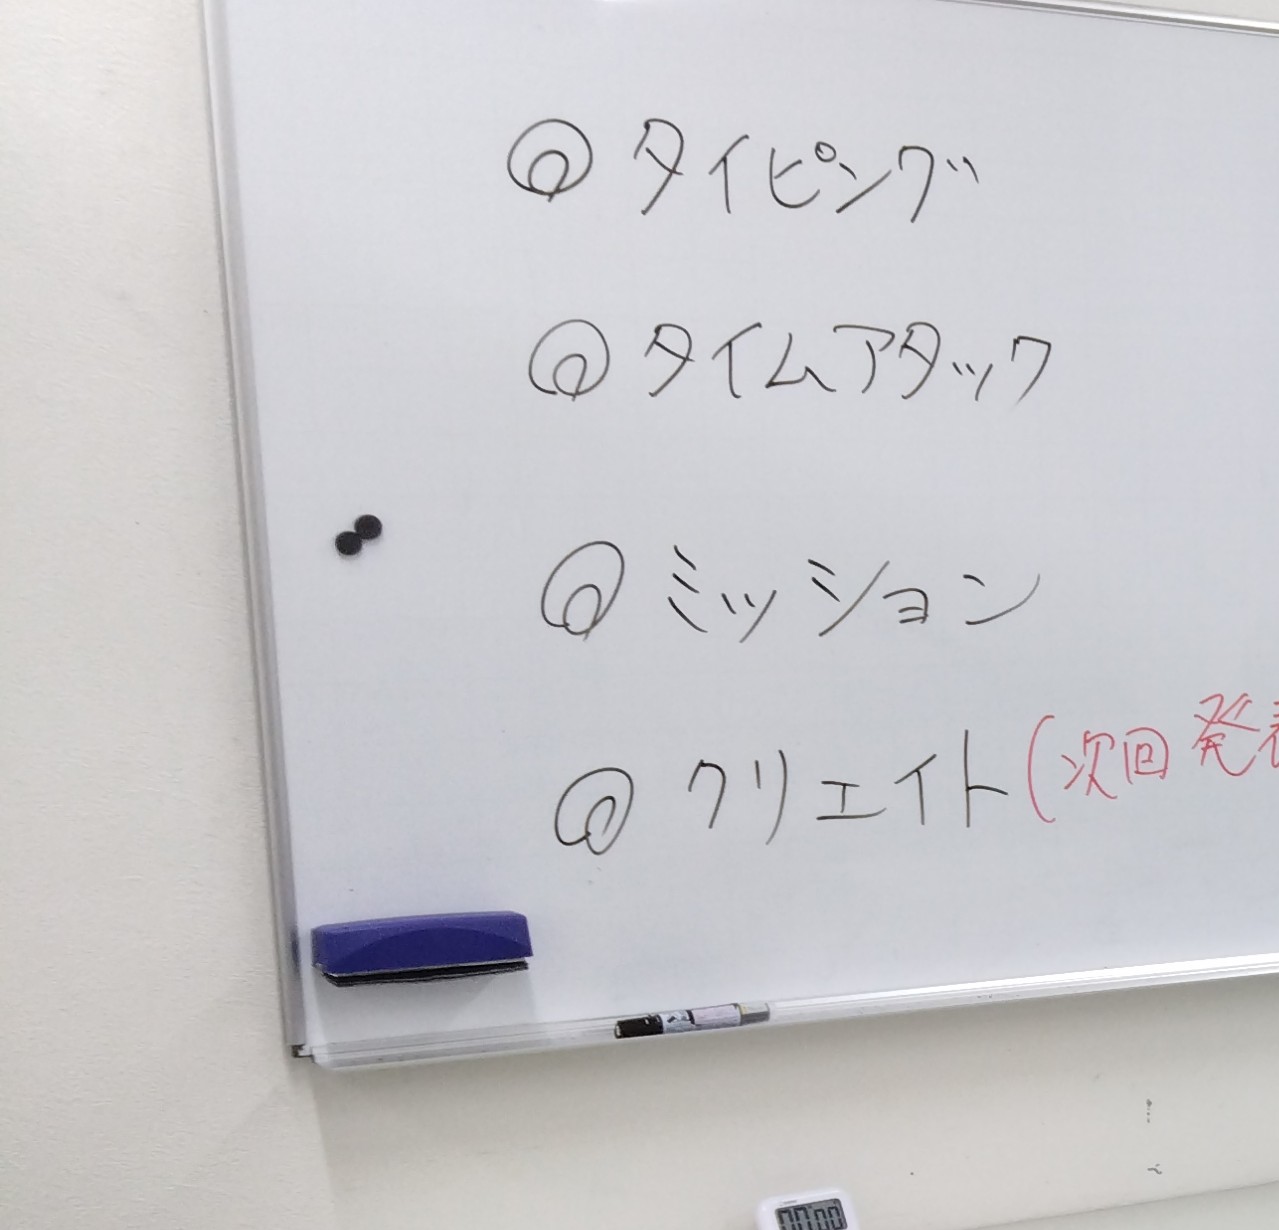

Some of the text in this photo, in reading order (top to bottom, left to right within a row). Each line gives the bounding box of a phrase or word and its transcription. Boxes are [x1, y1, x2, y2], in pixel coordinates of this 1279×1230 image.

[633, 117, 979, 223] タイピング
[643, 320, 1053, 403] タイムアタック
[667, 545, 1041, 643] ミッション
